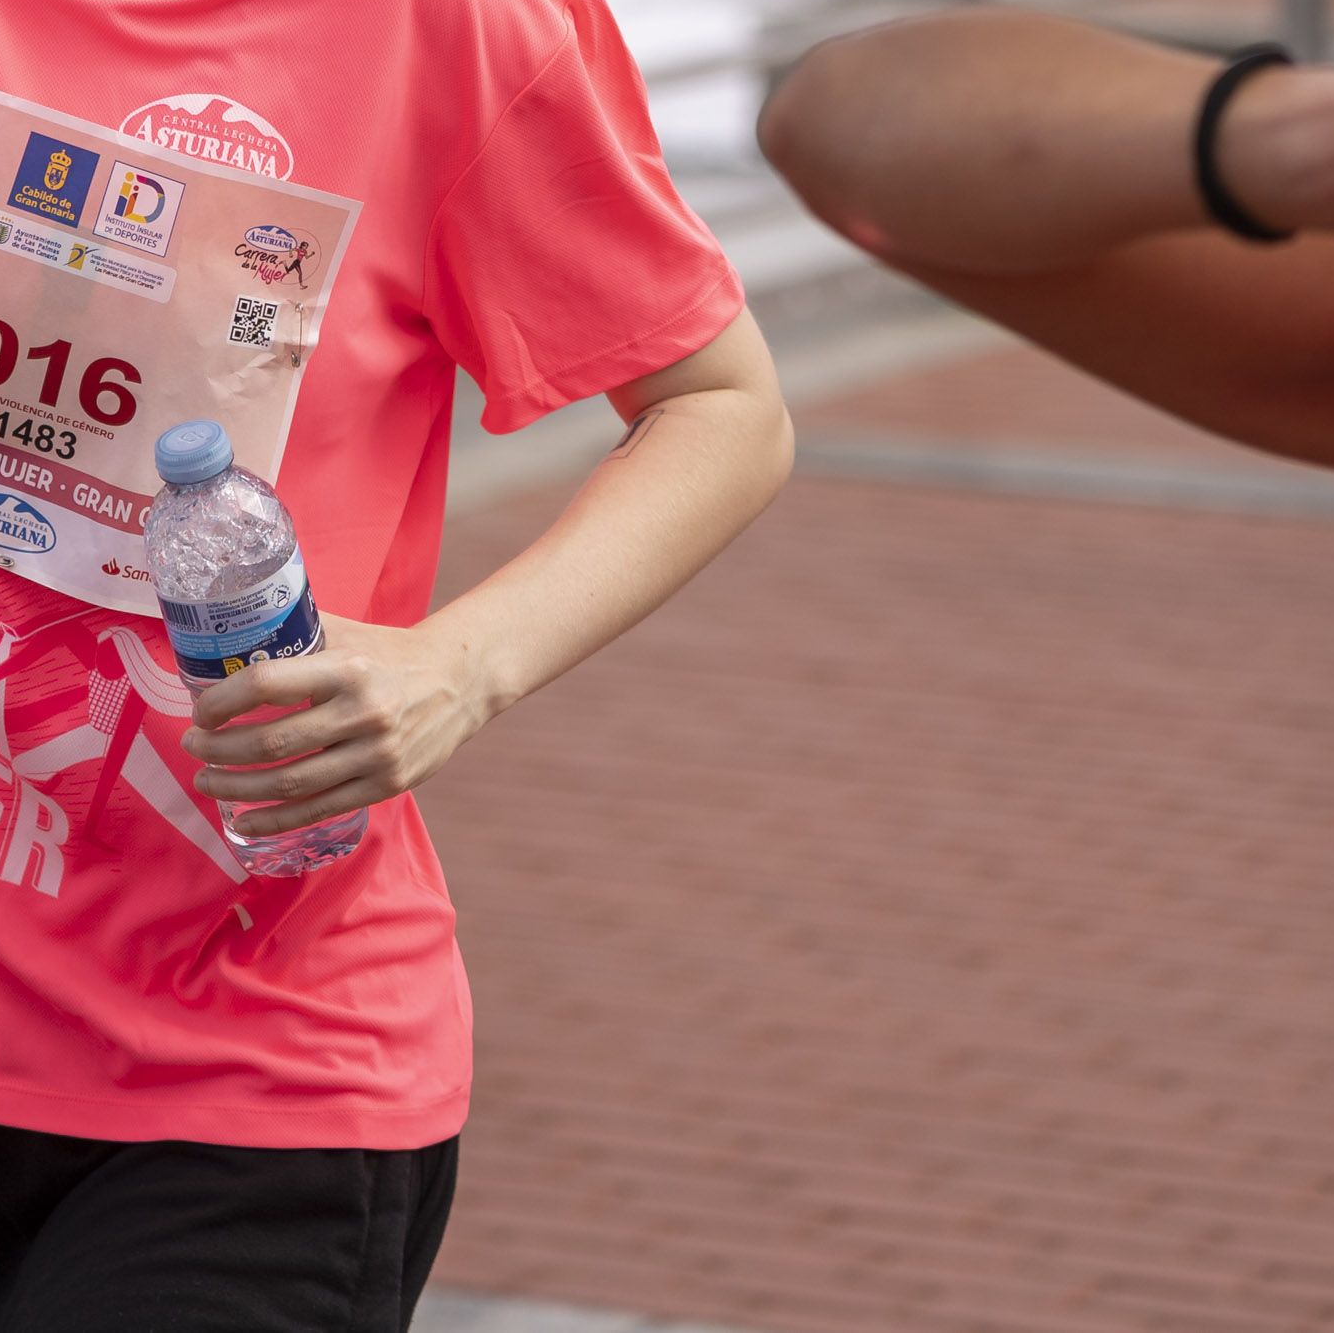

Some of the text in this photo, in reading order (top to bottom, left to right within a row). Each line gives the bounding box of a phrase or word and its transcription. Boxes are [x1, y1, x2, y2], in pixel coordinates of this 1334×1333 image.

[162, 114, 278, 152] CENTRAL LECHERA
[134, 114, 278, 179] ASTURIANA
[14, 193, 76, 222] Gran Canaria
[21, 184, 72, 210] Cabildo de
[13, 235, 60, 255] de Las Palmas
[15, 228, 62, 249] Ayuntamiento
[247, 230, 293, 250] ASTURIANA
[11, 241, 58, 262] de Gran Canaria
[234, 243, 279, 266] Carrera
[257, 261, 288, 285] Mujer
[0, 396, 55, 422] VIOLENCIA
[56, 414, 70, 426] DE
[71, 420, 115, 441] GÉNERO
[72, 482, 134, 524] GRAN
[13, 512, 49, 533] LECHERA
[122, 565, 152, 584] San
[276, 638, 304, 659] 50 cl
